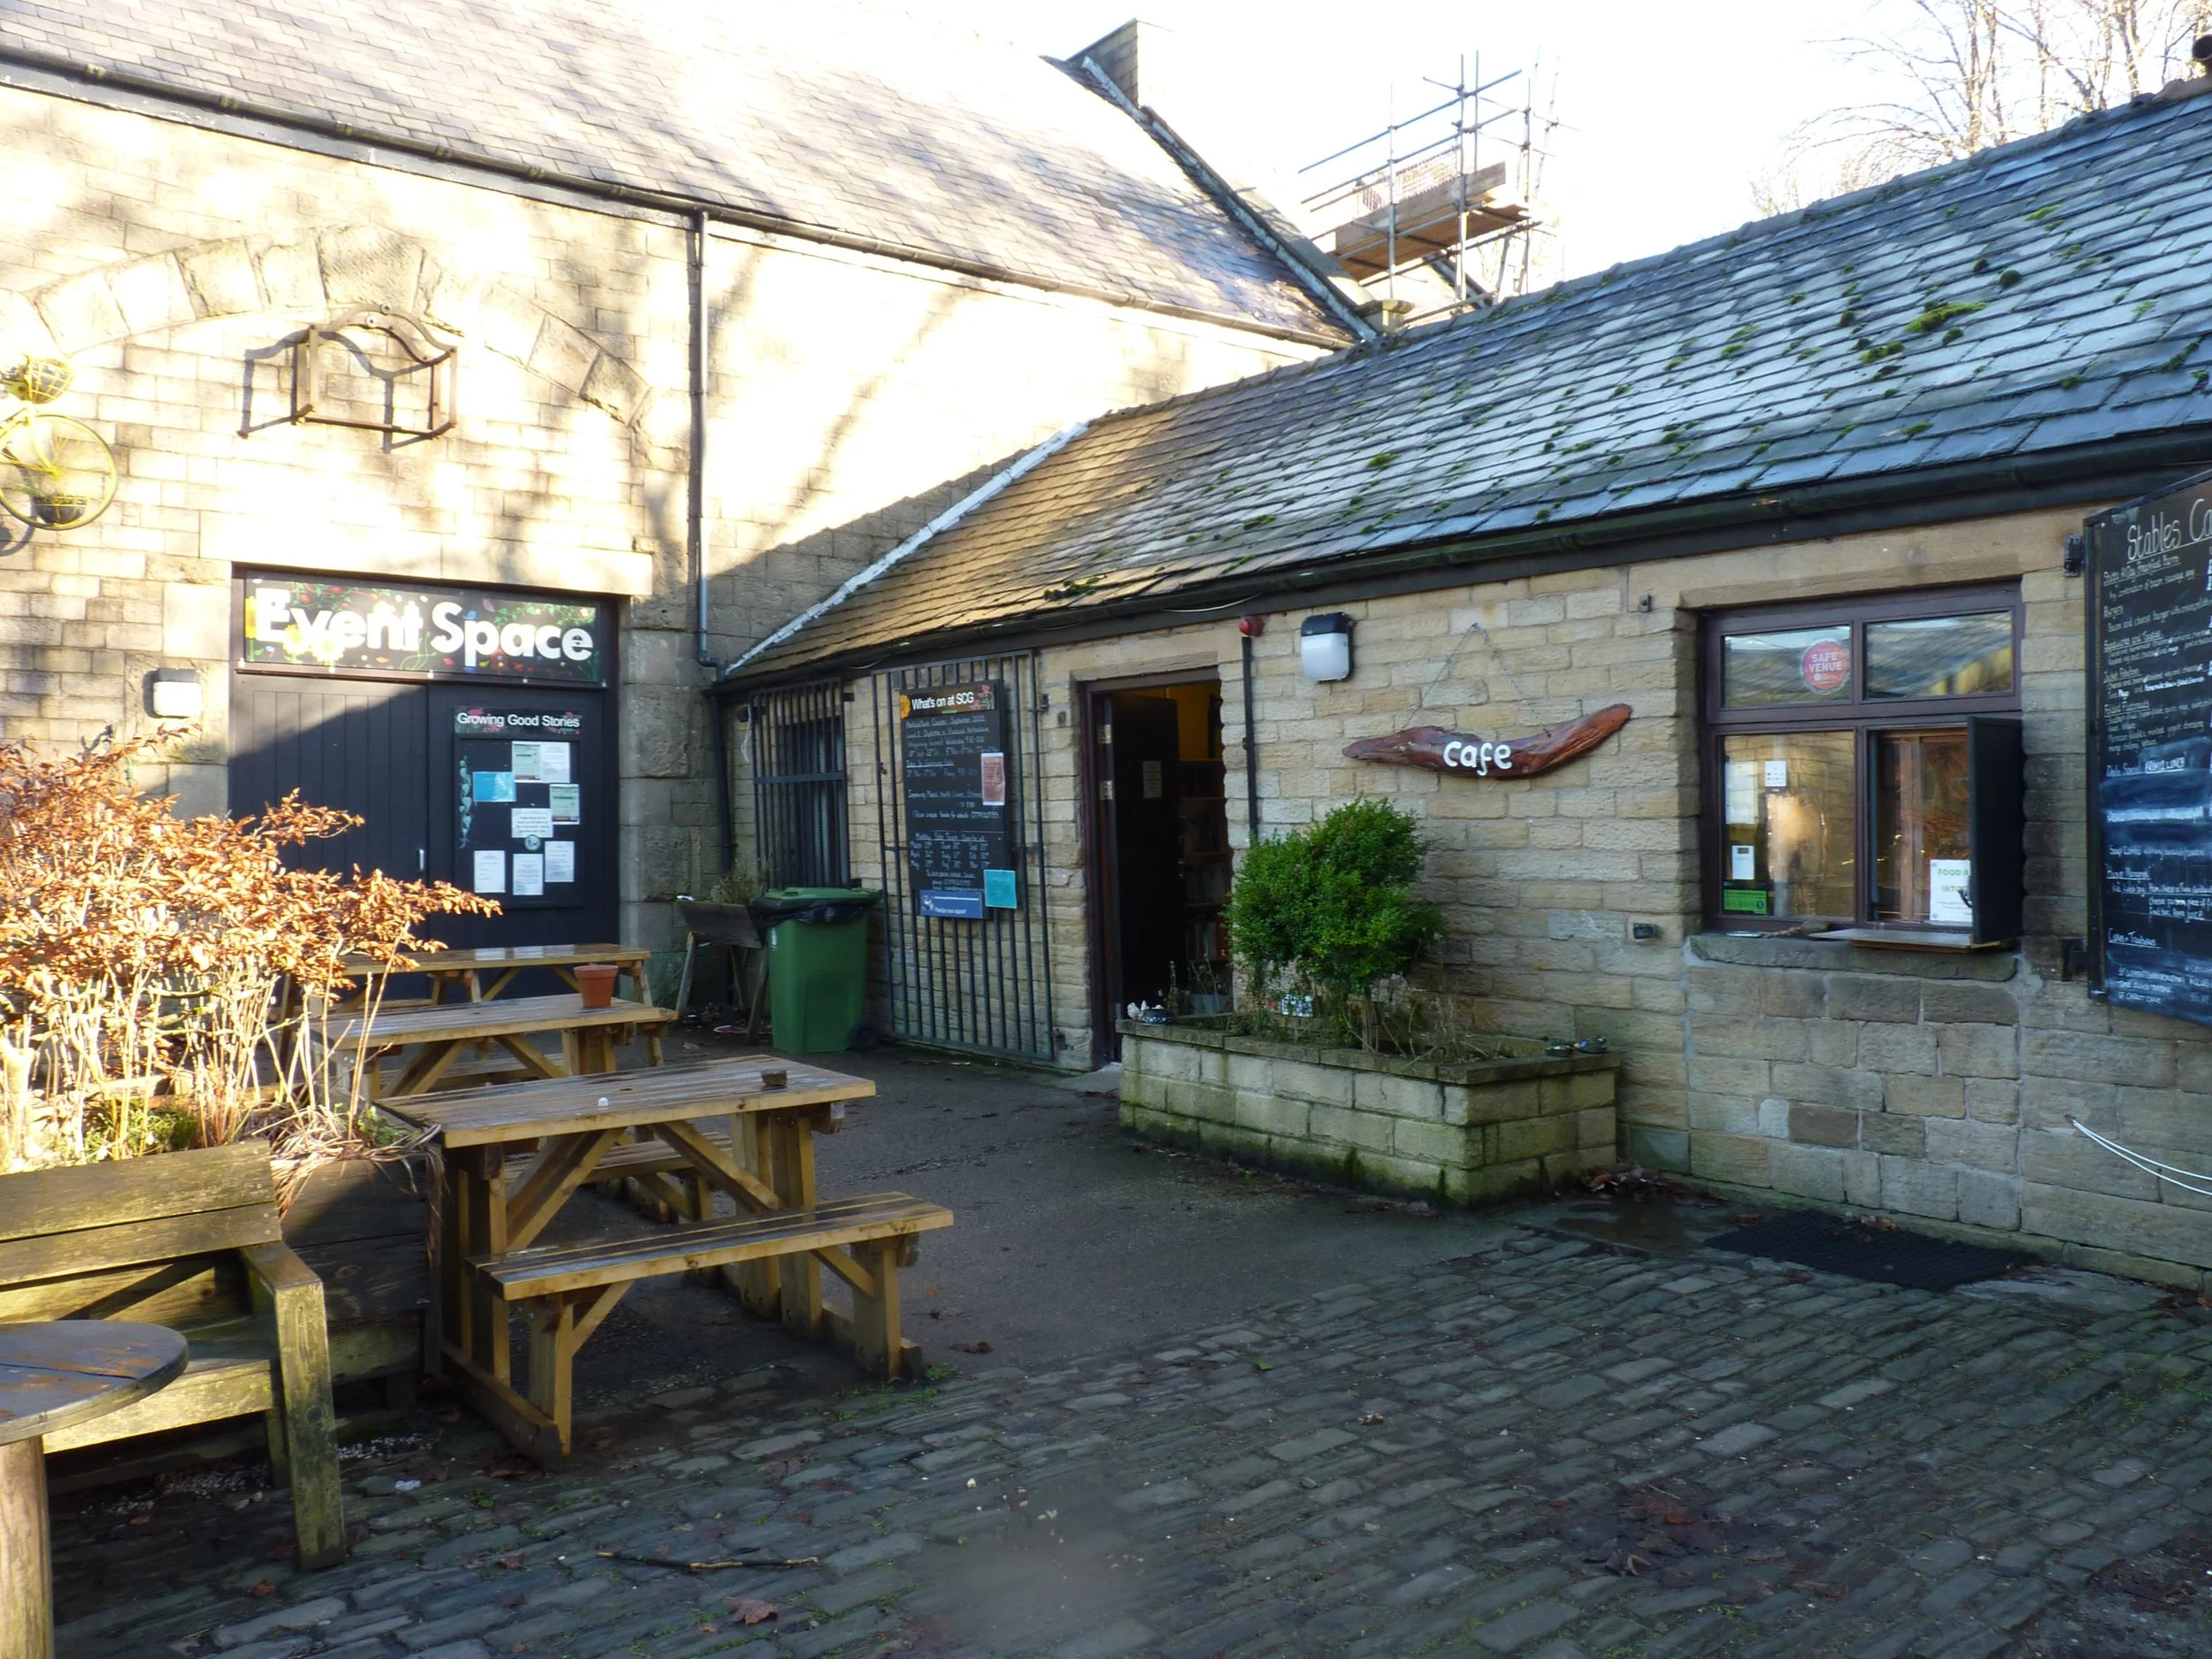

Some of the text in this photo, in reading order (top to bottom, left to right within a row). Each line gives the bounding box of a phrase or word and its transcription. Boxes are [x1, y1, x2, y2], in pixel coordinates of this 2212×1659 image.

[2127, 511, 2182, 561] Stables
[255, 587, 593, 667] Event Space
[1811, 651, 1838, 663] SAFE
[1809, 661, 1842, 672] VENUE
[911, 691, 974, 710] What's on at SCG
[457, 711, 580, 728] Growing Good Stories
